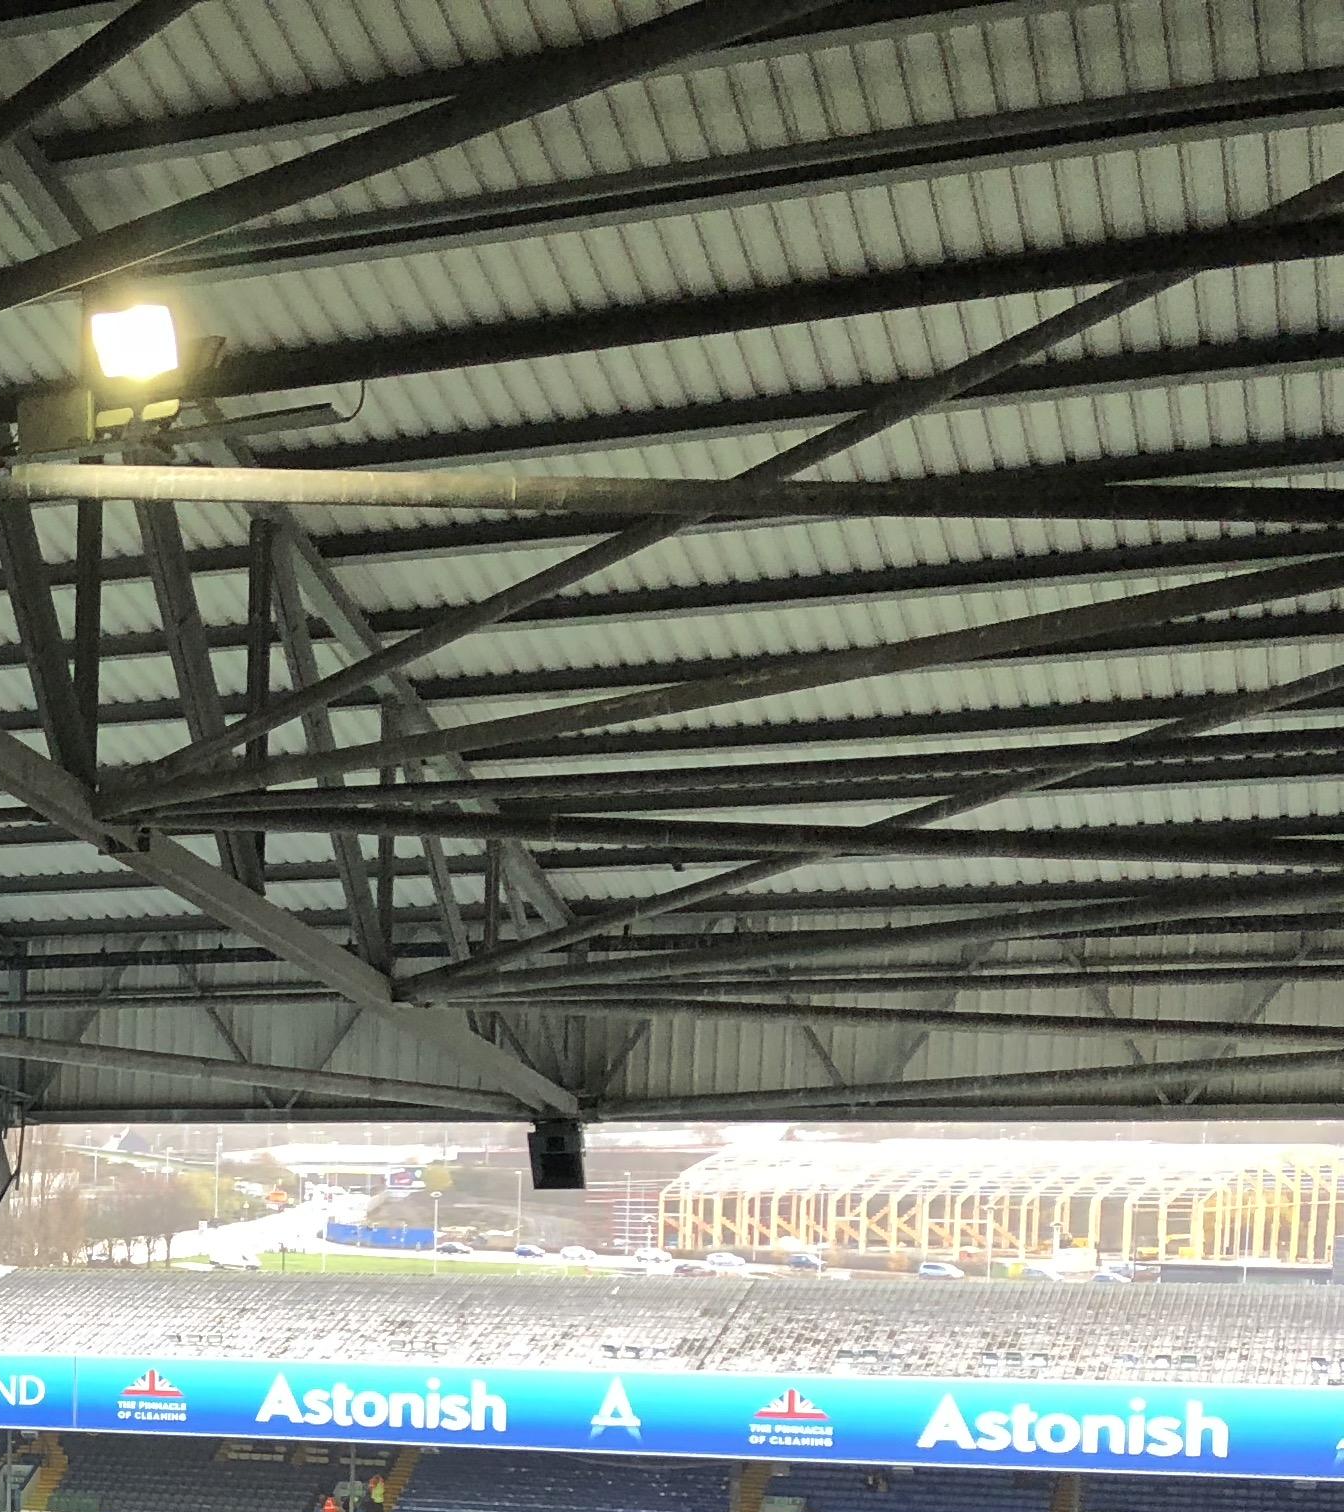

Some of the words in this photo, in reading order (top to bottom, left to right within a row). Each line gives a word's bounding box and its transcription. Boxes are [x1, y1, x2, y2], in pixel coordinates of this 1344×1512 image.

[117, 1400, 137, 1410] THE
[138, 1401, 187, 1412] PINNACLE
[255, 1372, 507, 1432] Astonish
[117, 1411, 133, 1420] OF
[134, 1411, 187, 1421] CLEANING
[749, 1424, 772, 1433] THE
[774, 1424, 834, 1435] PINNACLE
[917, 1392, 1230, 1458] Astonish
[748, 1435, 767, 1444] OF
[769, 1436, 834, 1447] CLEANING
